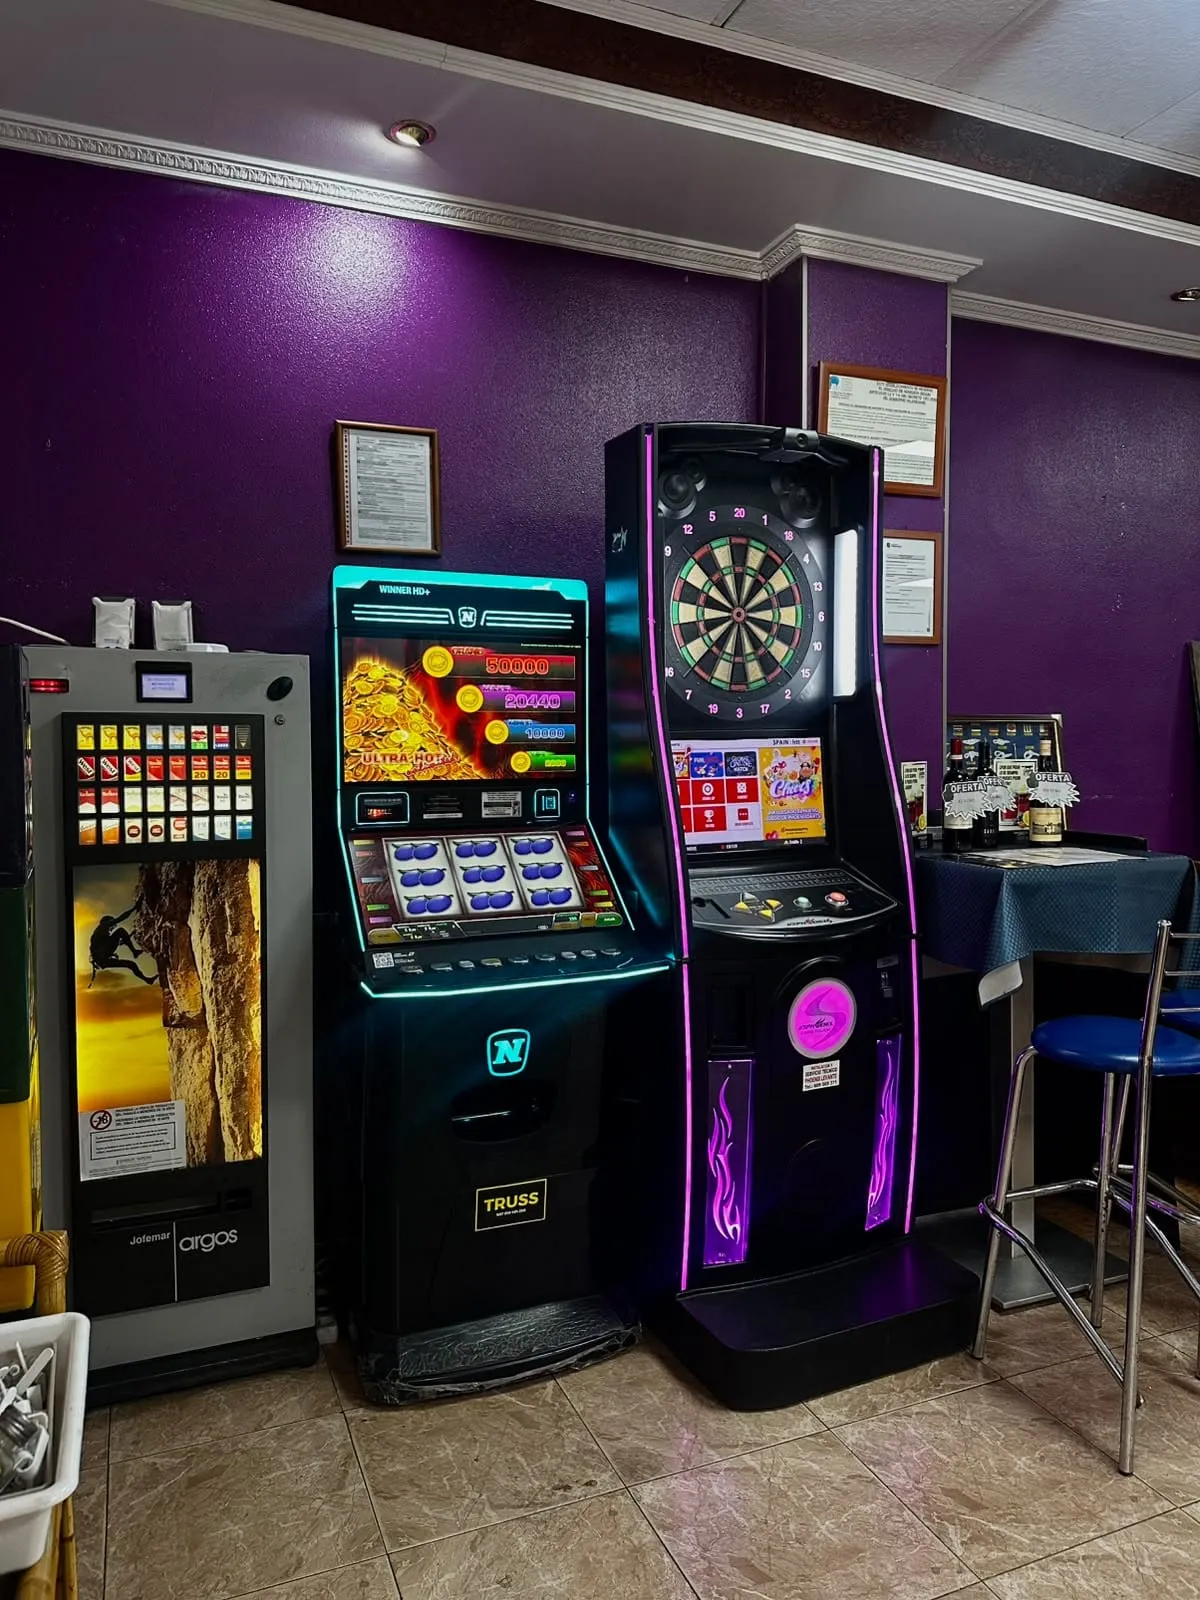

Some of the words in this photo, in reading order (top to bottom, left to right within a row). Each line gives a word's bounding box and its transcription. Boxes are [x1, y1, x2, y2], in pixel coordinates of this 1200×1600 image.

[709, 511, 716, 522] 5
[734, 508, 745, 518] 20
[762, 515, 768, 526] 1
[682, 524, 694, 535] 12
[783, 531, 794, 541] 18
[664, 546, 672, 556] 9
[803, 553, 810, 564] 4
[379, 584, 412, 595] WINNER
[412, 587, 431, 596] HD+
[813, 582, 823, 591] 13
[817, 611, 825, 622] 6
[812, 641, 822, 651] 10
[486, 657, 549, 675] 50000
[665, 667, 674, 677] 16
[801, 669, 811, 679] 15
[685, 690, 692, 700] 7
[784, 689, 791, 700] 2
[505, 694, 561, 709] 20440
[708, 704, 719, 714] 19
[736, 708, 743, 718] 3
[760, 703, 770, 714] 17
[525, 728, 565, 739] 10000
[361, 752, 409, 765] ULTRA
[79, 758, 93, 774] West
[102, 758, 116, 774] West
[1035, 774, 1070, 783] OFERTA
[950, 782, 984, 793] OFERTA
[492, 1038, 526, 1065] N
[483, 1191, 539, 1213] TRUSS
[130, 1231, 171, 1245] Jofemar
[179, 1229, 238, 1252] argos
